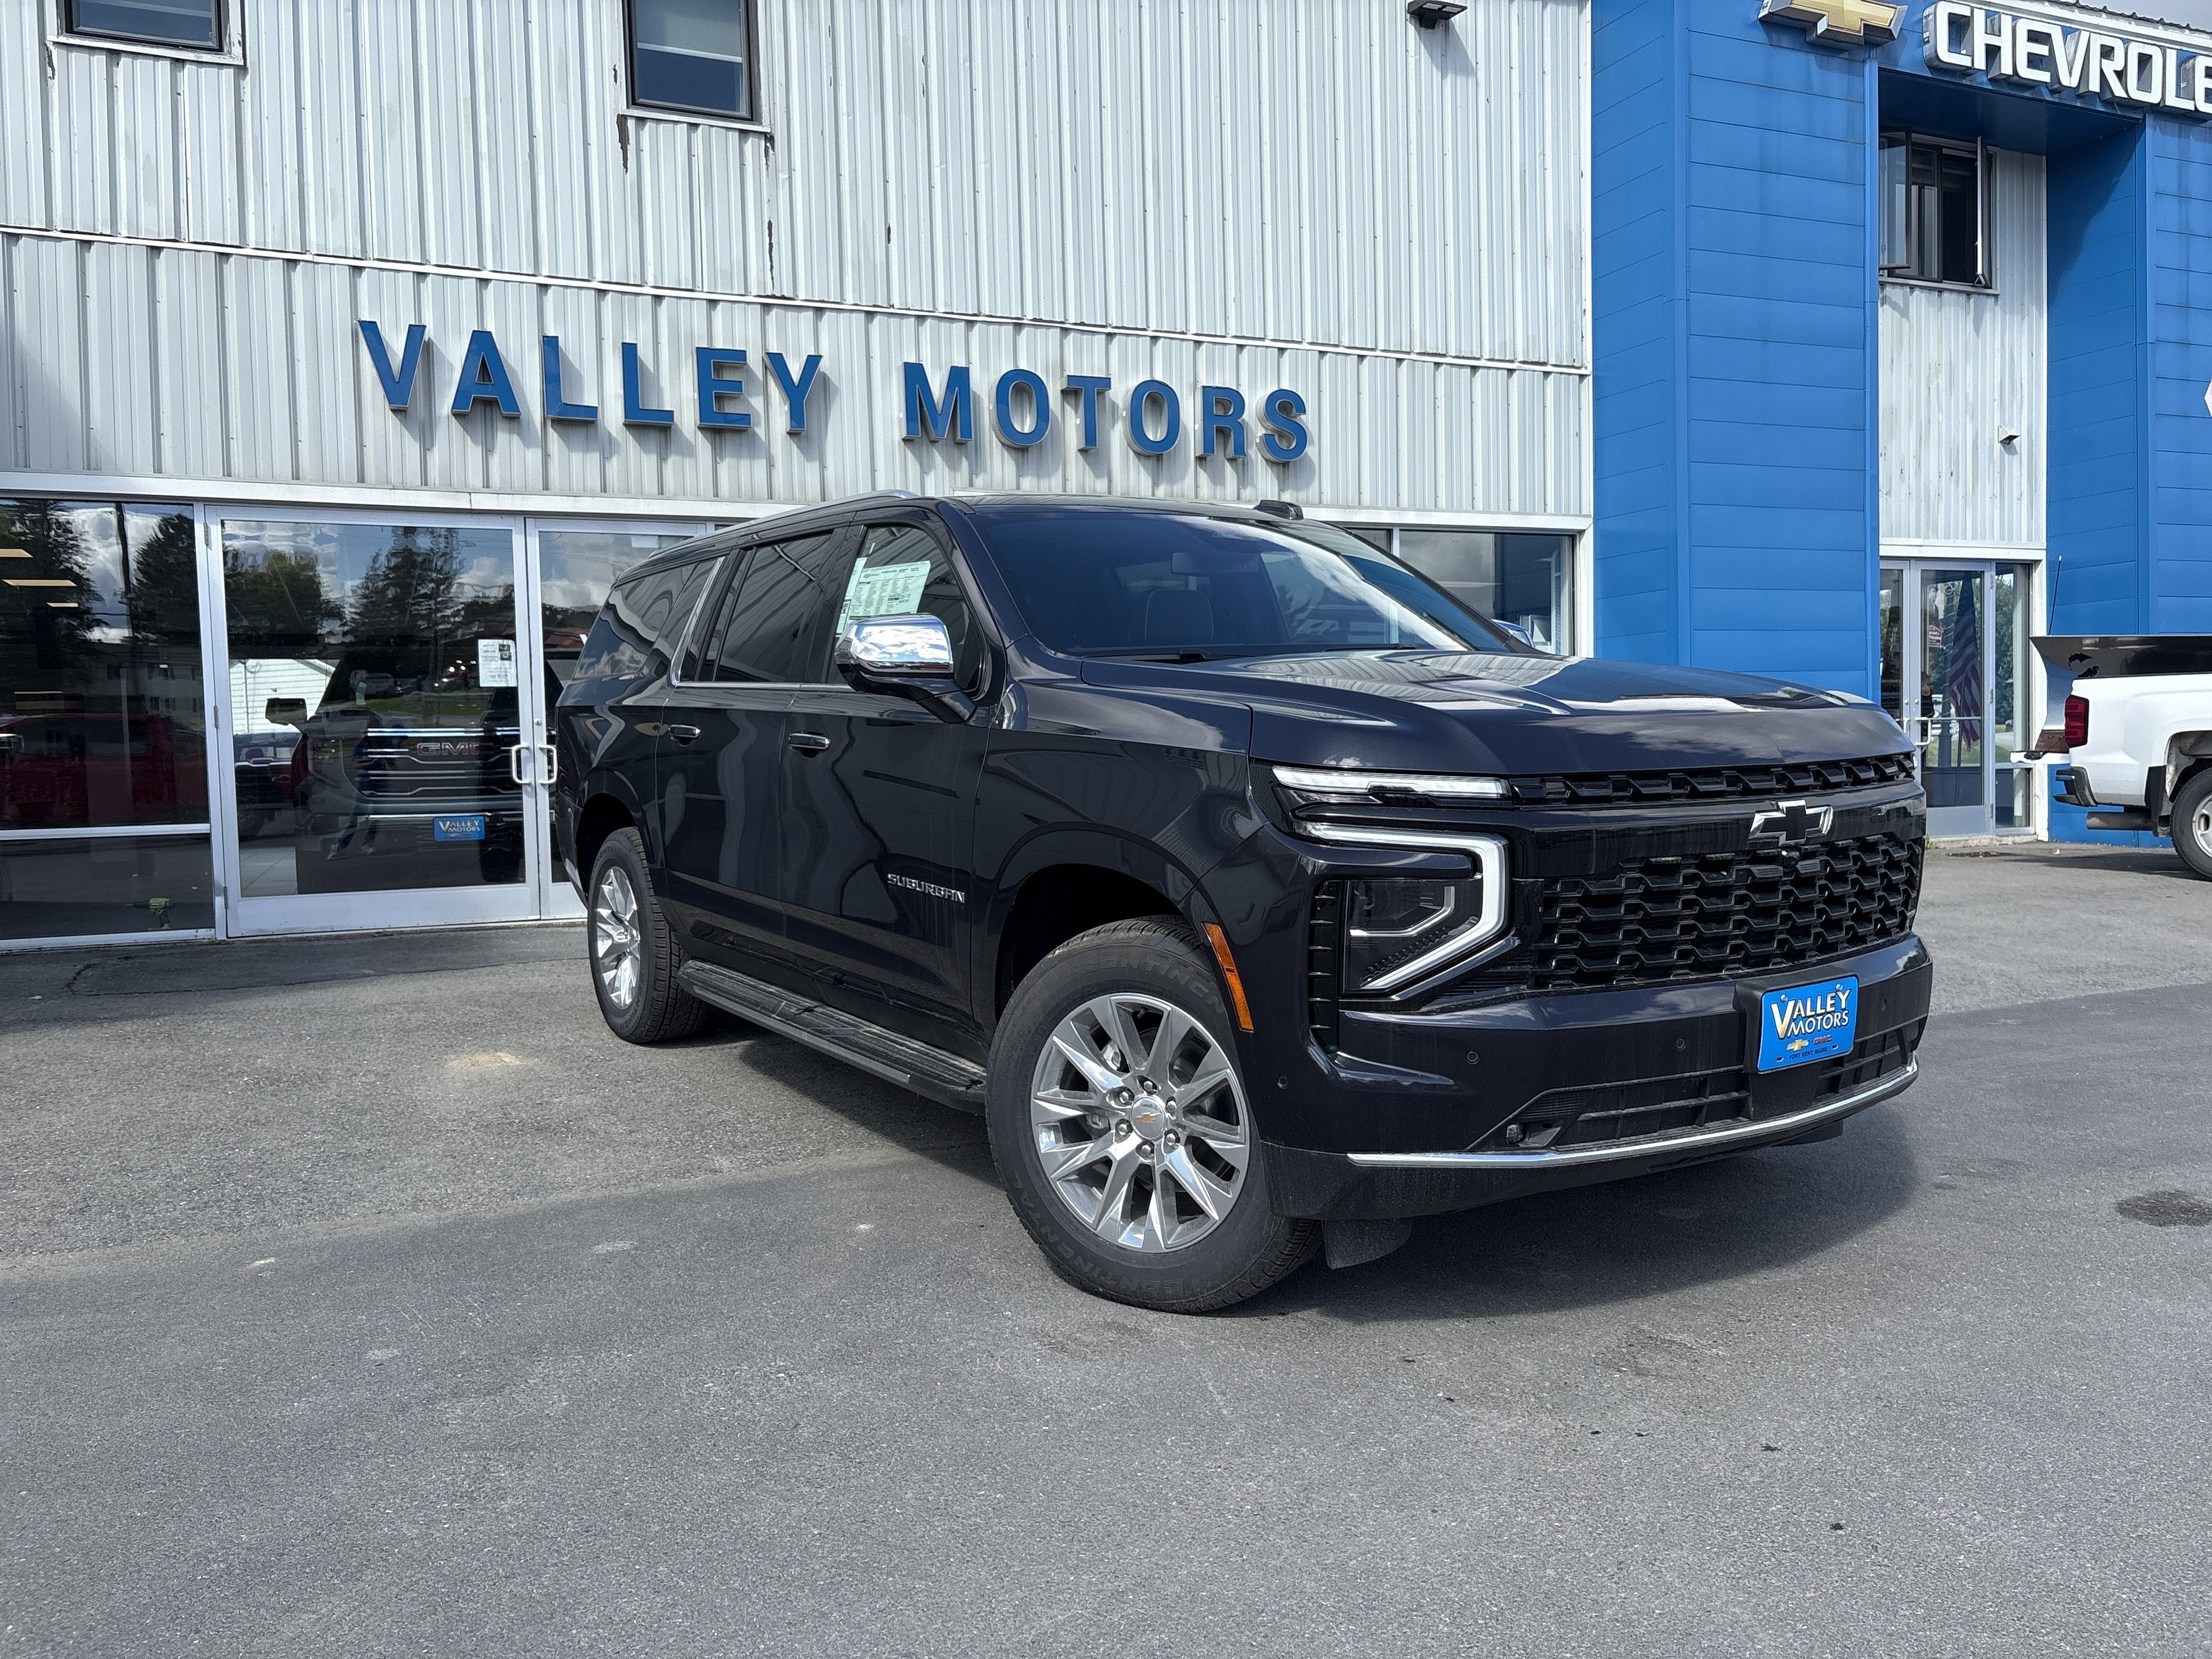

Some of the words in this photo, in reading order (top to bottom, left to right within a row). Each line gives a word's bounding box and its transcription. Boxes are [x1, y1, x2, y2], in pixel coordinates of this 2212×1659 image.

[358, 320, 822, 434] VALLEY
[901, 362, 1309, 464] MOTORS
[417, 742, 493, 755] GMC
[439, 820, 479, 832] VALLEY
[887, 873, 965, 904] SUBURBAN
[1770, 989, 1852, 1039] VALLEY
[1787, 1010, 1849, 1037] MOTORS
[1788, 1052, 1802, 1060] FORT
